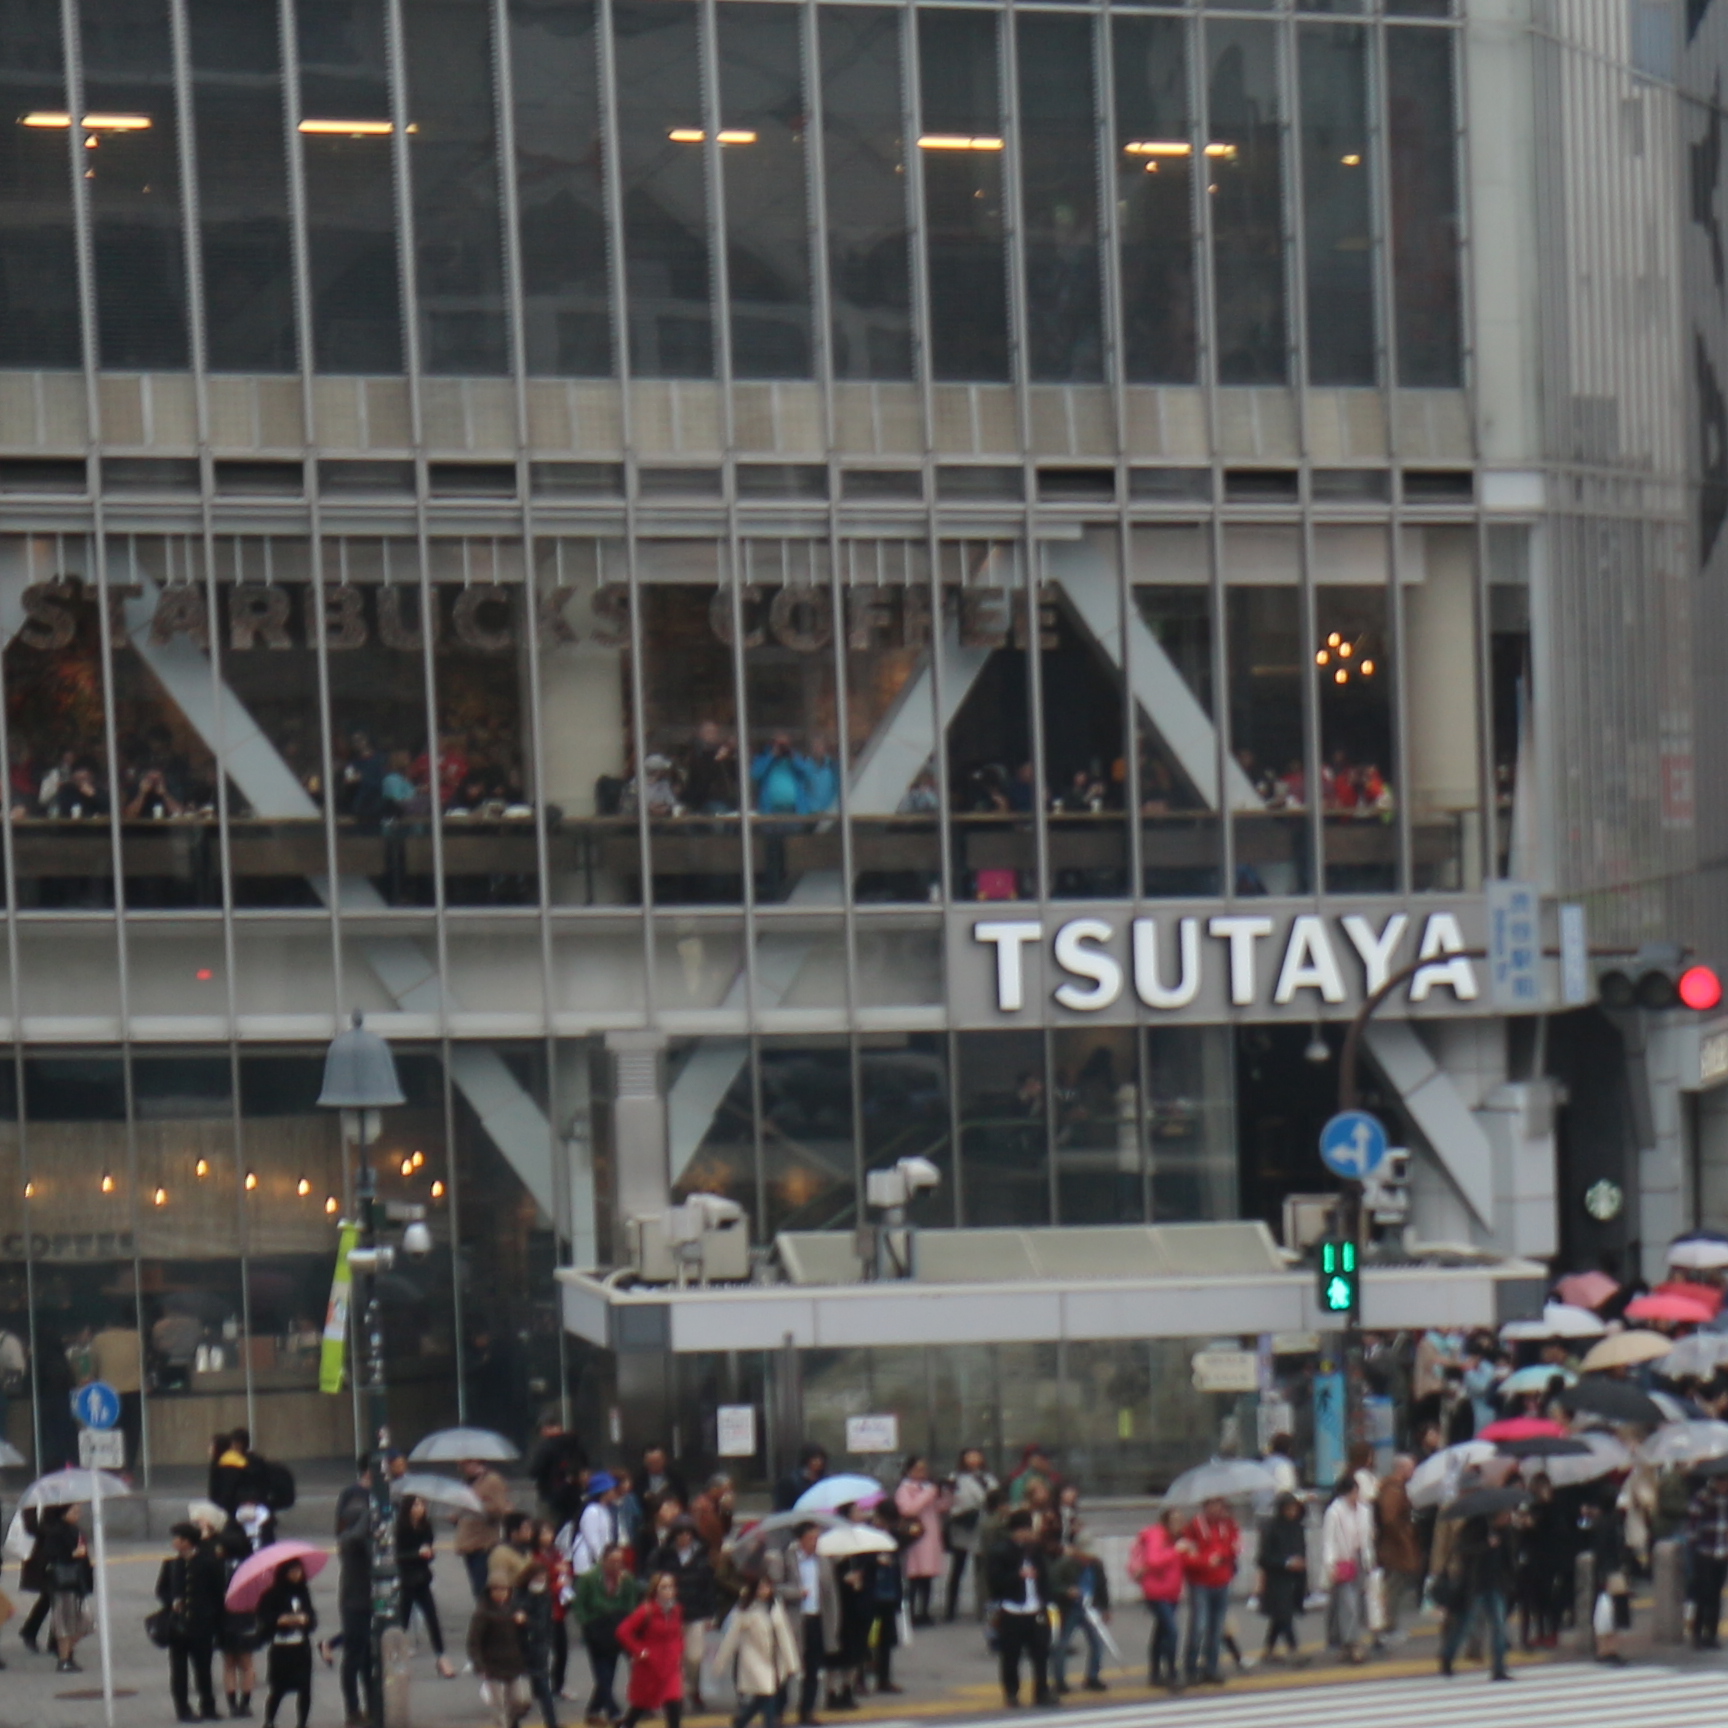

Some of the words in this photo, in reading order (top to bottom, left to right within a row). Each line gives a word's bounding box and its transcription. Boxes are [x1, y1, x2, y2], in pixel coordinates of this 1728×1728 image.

[19, 580, 634, 652] STARBUCKS
[710, 581, 1060, 651] COFFEE
[973, 911, 1480, 1014] TSUTAYA
